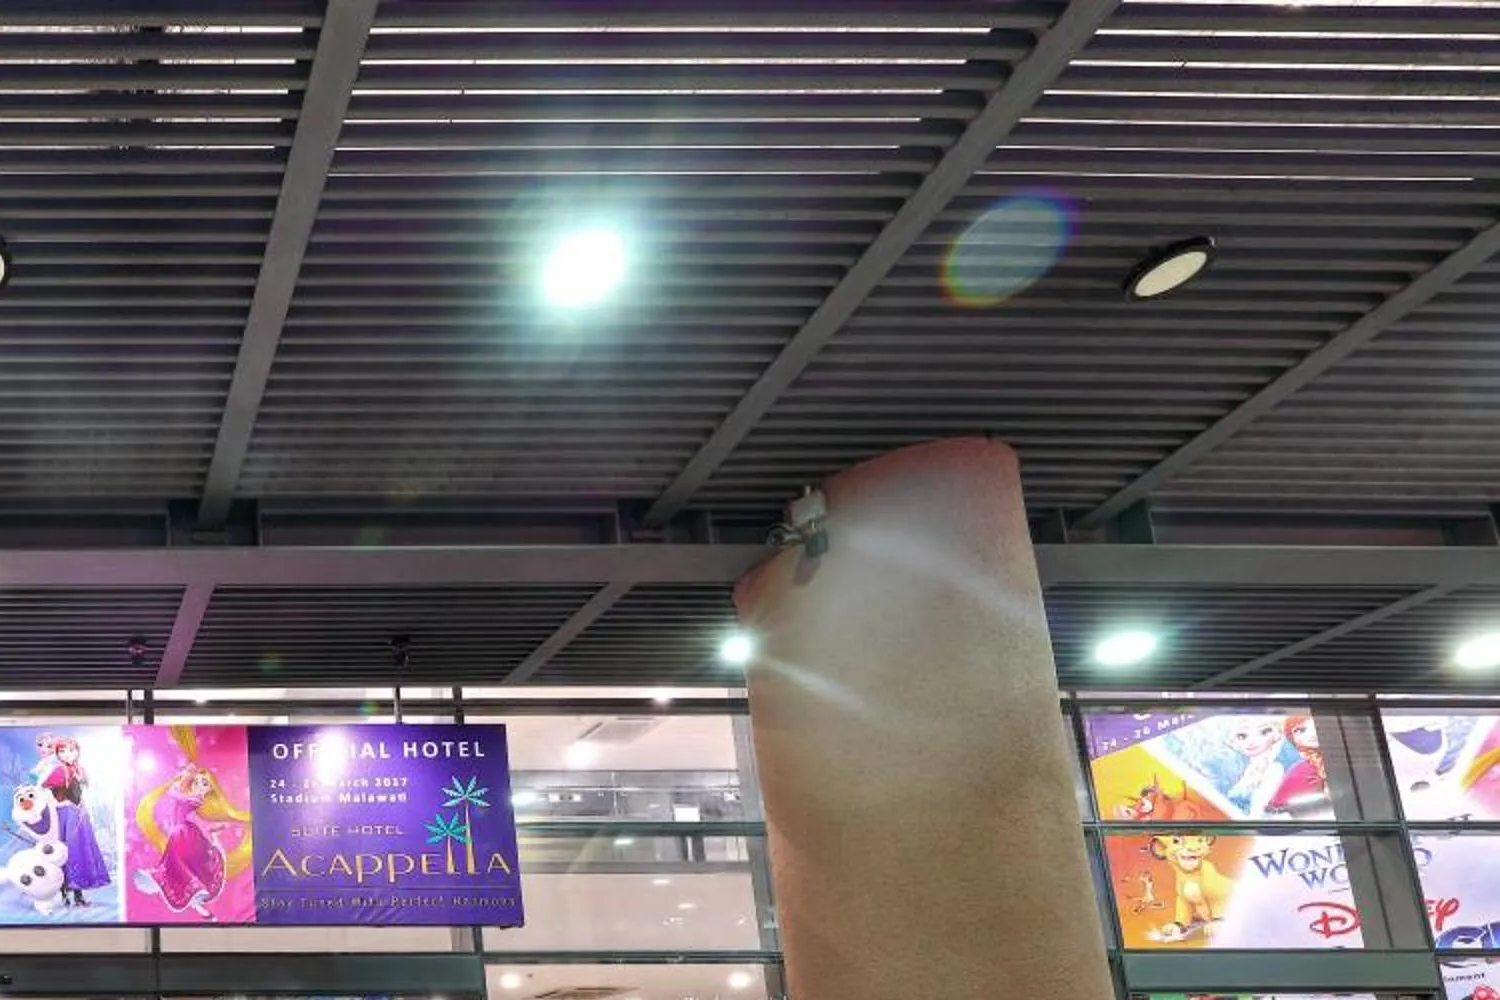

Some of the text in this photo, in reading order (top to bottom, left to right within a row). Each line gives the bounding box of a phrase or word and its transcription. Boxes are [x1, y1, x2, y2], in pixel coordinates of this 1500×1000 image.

[272, 741, 485, 760] OFFIAL HOTEL
[269, 779, 285, 789] 24
[374, 777, 408, 788] 2017
[348, 824, 405, 836] HOTEL
